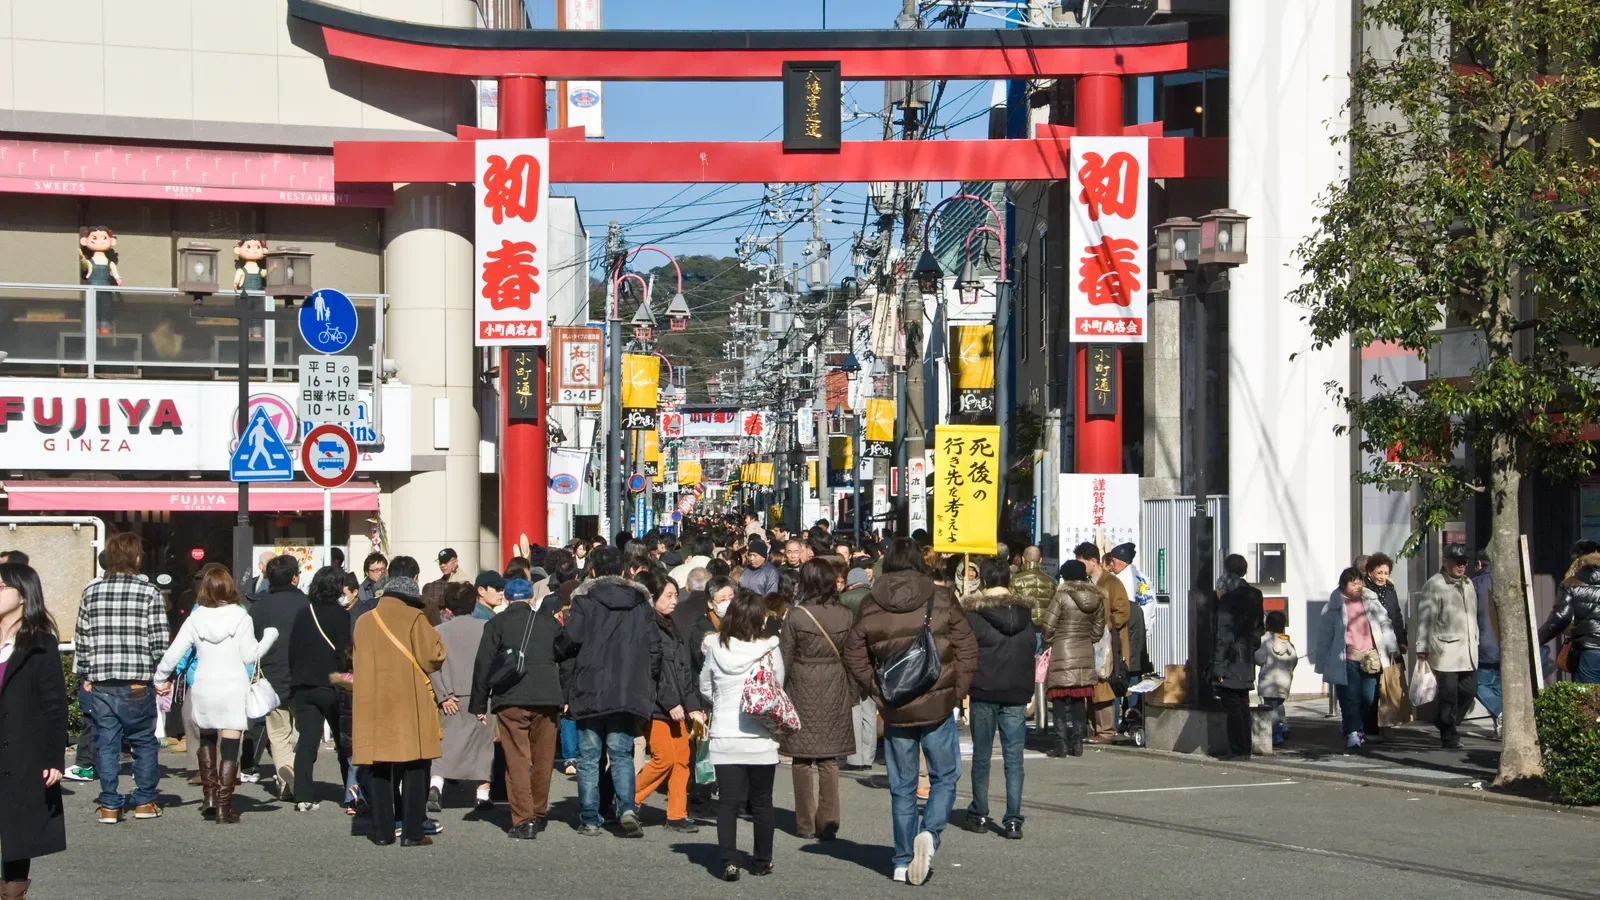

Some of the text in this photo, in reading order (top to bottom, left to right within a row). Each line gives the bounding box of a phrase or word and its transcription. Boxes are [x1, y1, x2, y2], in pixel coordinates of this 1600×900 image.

[35, 181, 85, 192] SWEETS
[165, 185, 202, 194] FUJIYA
[279, 191, 350, 204] RESTAURANT
[482, 153, 541, 311] 初春
[1078, 151, 1141, 307] 初春
[484, 323, 537, 337] 小町商店会
[1080, 319, 1138, 334] 小町商店会
[308, 361, 350, 374] 平日の
[569, 345, 591, 383] 和民
[1094, 350, 1111, 406] 小町通り
[515, 352, 533, 410] 小町通り
[0, 396, 182, 434] FUJIYA
[744, 413, 763, 436] 春
[43, 438, 131, 452] GINZA
[303, 421, 377, 442] Rins
[967, 437, 995, 502] 死後の
[170, 494, 226, 505] FUJIYA
[911, 477, 921, 521] ホテル
[943, 437, 965, 543] 行き先を考えよ
[1092, 478, 1106, 527] 謹賀新年
